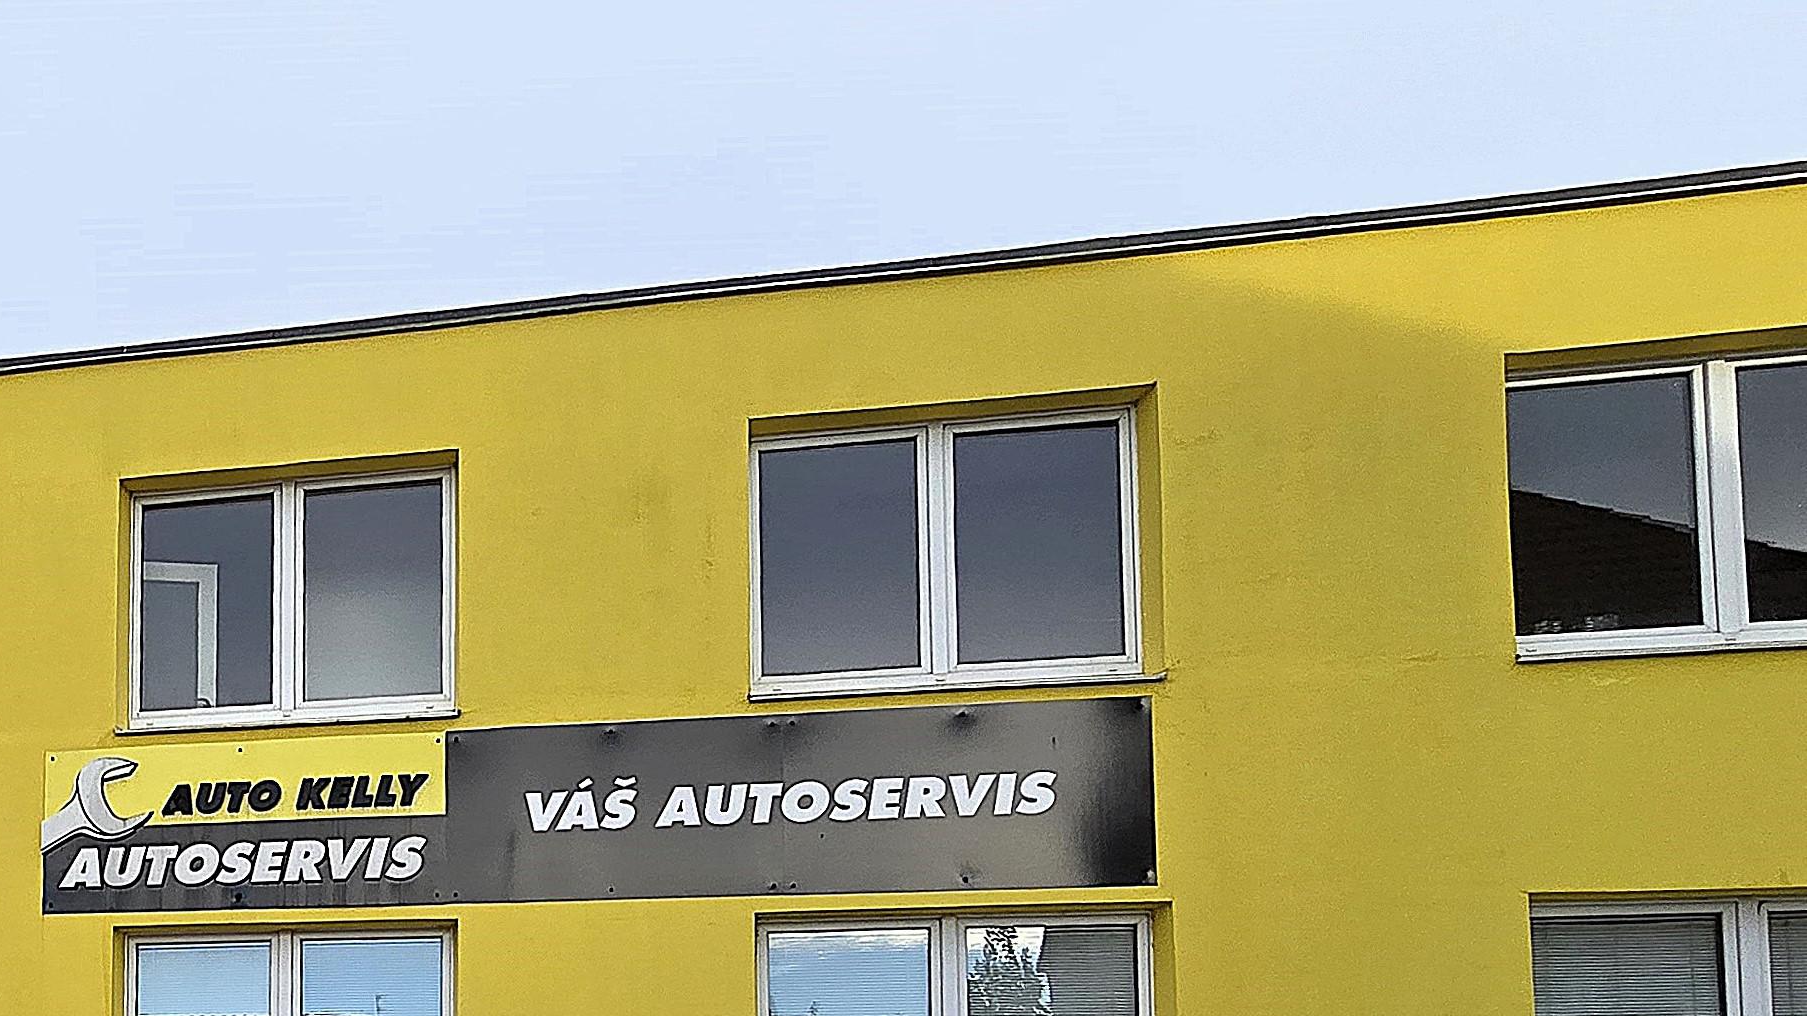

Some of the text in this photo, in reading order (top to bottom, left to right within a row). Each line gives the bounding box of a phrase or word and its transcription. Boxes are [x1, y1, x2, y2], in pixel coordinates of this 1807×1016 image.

[162, 774, 429, 817] AUTO KELLY
[526, 771, 1057, 831] VÁŠ AUTOSERVIS
[58, 836, 427, 888] AUTOSERVIS
